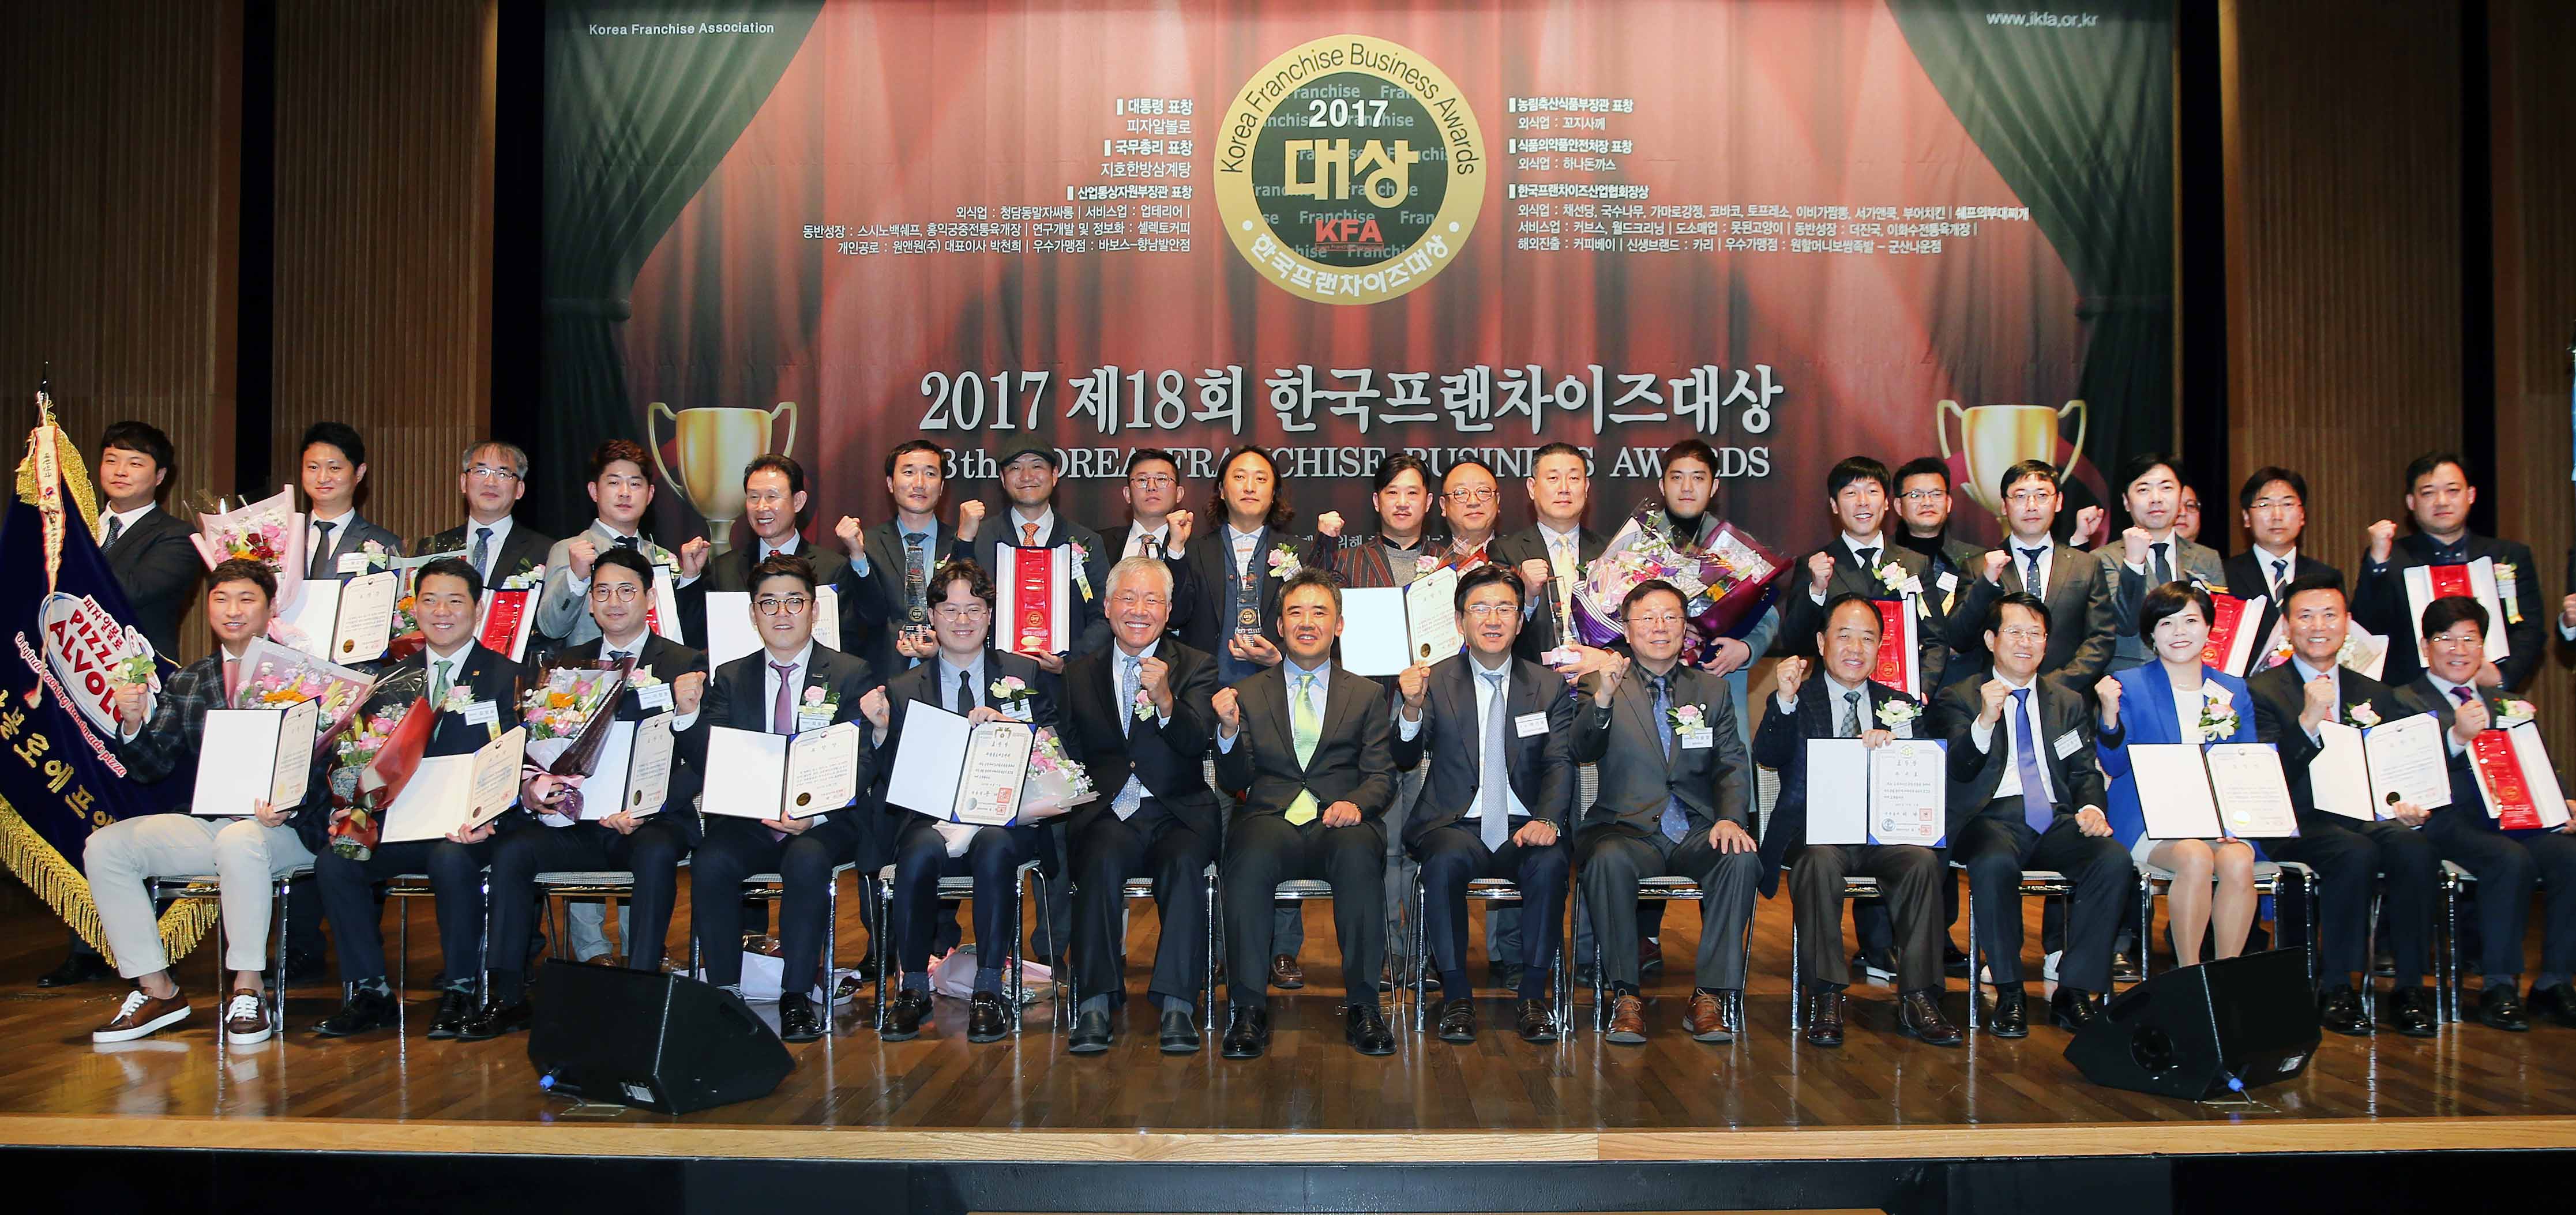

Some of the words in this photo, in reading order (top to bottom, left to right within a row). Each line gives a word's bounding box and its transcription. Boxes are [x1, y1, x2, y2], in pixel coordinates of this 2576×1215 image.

[1986, 12, 2098, 28] www.ikfa.or.kr
[589, 24, 627, 35] Korea
[632, 24, 694, 35] Franchise
[699, 22, 774, 33] Association
[1128, 99, 1163, 115] 대통령
[1167, 99, 1193, 115] 표창
[1221, 112, 1258, 172] Korea
[1245, 49, 1343, 112] Franchise
[1350, 43, 1439, 99] Business
[1433, 97, 1479, 175] Awards
[1518, 97, 1609, 112] 농림축산식품부장관
[1612, 99, 1634, 113] 표창
[1309, 99, 1389, 128] 2017
[1126, 118, 1191, 135] 피자알볼로
[1518, 116, 1550, 130] 외식업
[1563, 116, 1606, 131] 꼬지사께
[1115, 139, 1163, 156] 국무총리
[1167, 140, 1193, 156] 표창
[1518, 138, 1609, 153] 식품의약품안전처장
[1610, 140, 1634, 154] 표창
[1101, 161, 1192, 178] 지호한방삼계탕
[1518, 156, 1550, 171] 외식업
[1563, 157, 1616, 171] 하나돈까스
[1285, 139, 1419, 208] 대상
[1077, 185, 1169, 200] 산업통상자원부장관
[1171, 186, 1193, 200] 표창
[1518, 183, 1650, 199] 한국프랜차이즈산업협회장상
[956, 206, 987, 219] 외식업
[1000, 205, 1074, 220] 청담동말자싸롱
[1085, 205, 1127, 219] 서비스업
[1140, 204, 1182, 219] 업테리어
[1518, 204, 1550, 217] 외식업
[1563, 204, 1598, 218] 채선당,
[1601, 204, 1646, 219] 국수나무,
[1650, 205, 1706, 219] 가마로강정,
[1709, 204, 1744, 218] 코바코,
[1747, 204, 1792, 219] 토프레소,
[1903, 207, 1946, 220] 부어치킨
[802, 224, 846, 239] 동반성장
[857, 223, 922, 238] 스시노백쉐프,
[927, 222, 1022, 237] 홍익궁중전통육개장
[1032, 223, 1075, 236] 연구개발
[1079, 223, 1089, 236] 및
[1092, 221, 1125, 235] 정보화
[1137, 221, 1191, 235] 셀렉토커피
[1316, 219, 1383, 242] KFA
[1518, 220, 1560, 234] 서비스업
[1573, 221, 1608, 235] 커브스,
[1612, 220, 1665, 235] 월드크리닝
[1676, 221, 1718, 235] 도소매업
[1731, 221, 1783, 235] 못된고양이
[1794, 222, 1837, 236] 동반성장
[838, 241, 880, 255] 개인공로
[892, 239, 941, 254] 원앤원(주)
[945, 239, 987, 253] 대표이사
[990, 239, 1022, 253] 박천희
[1032, 239, 1086, 253] 우수가맹점
[1518, 237, 1560, 251] 해외진출
[1573, 238, 1616, 251] 커피베이
[1627, 238, 1680, 253] 신생브랜드
[1693, 238, 1713, 251] 카리
[1725, 238, 1778, 252] 우수가맹점
[1888, 239, 1942, 254] 군산나운점
[1251, 234, 1448, 296] 한국프랜차이즈대상
[919, 371, 1049, 431] 2017
[1065, 364, 1242, 435] 제18회
[1264, 364, 1784, 435] 한국프랜차이즈대상
[944, 448, 1000, 479] 8th
[1053, 447, 1136, 478] REA
[1609, 446, 1770, 478] AWDS
[16, 631, 45, 674] Origina
[99, 750, 127, 777] pizza
